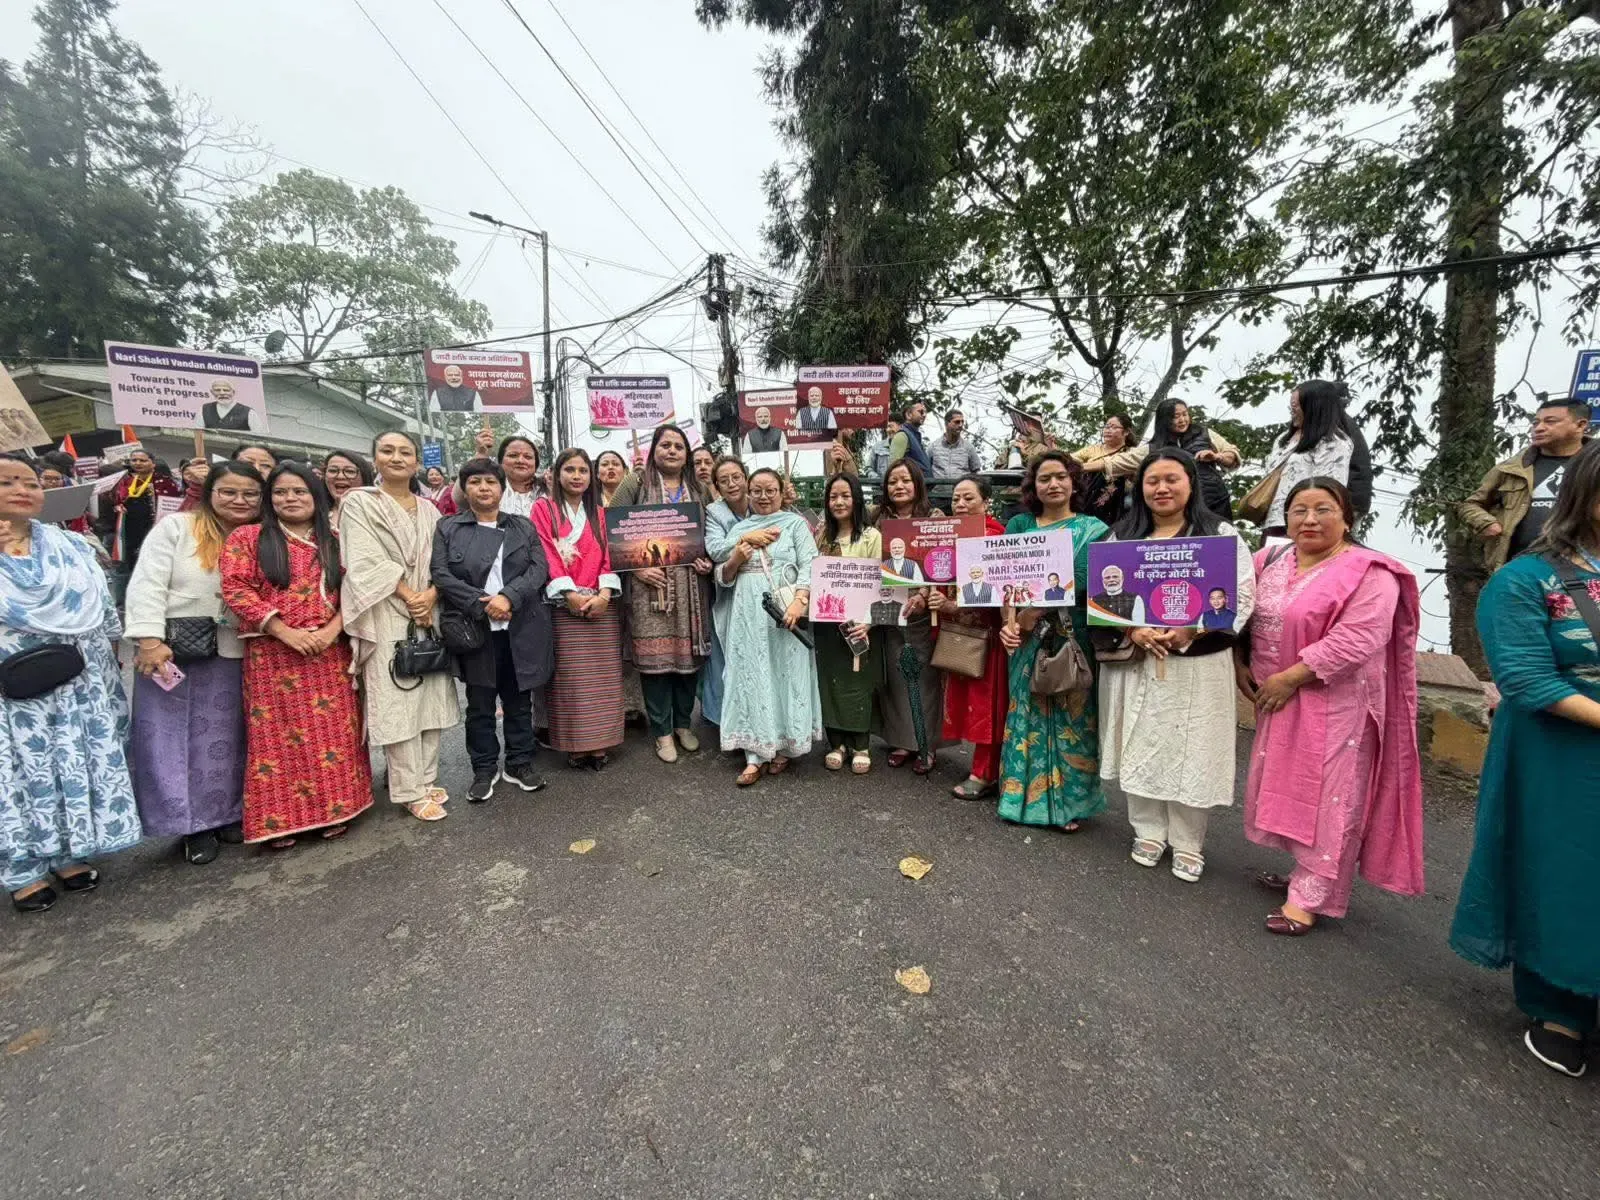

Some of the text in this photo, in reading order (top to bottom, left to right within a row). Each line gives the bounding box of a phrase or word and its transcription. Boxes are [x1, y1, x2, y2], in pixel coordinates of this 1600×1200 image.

[115, 352, 254, 375] Nari Shakti Vandan Adhiniyam
[804, 370, 817, 378] नारी
[818, 370, 834, 378] शक्ति
[851, 370, 884, 378] अधिनियम
[130, 373, 196, 387] Towards The
[490, 379, 521, 388] अधिकार
[118, 384, 210, 399] Nation's Progress
[862, 387, 880, 396] भारत
[1578, 382, 1599, 391] AND
[157, 398, 176, 406] and
[846, 395, 870, 404] के लिए
[142, 408, 196, 420] Prosperity
[868, 405, 884, 414] आगे
[920, 525, 954, 534] धन्यवाद
[984, 536, 1046, 548] THANK YOU
[981, 554, 996, 562] SHRI
[996, 552, 1028, 560] NARENDRA
[1029, 550, 1044, 558] MODI
[1144, 550, 1194, 562] धन्यवाद
[826, 562, 841, 570] नारी
[842, 563, 858, 571] शक्ति
[988, 564, 1045, 575] NARI SHAKTI
[820, 571, 862, 580] अधिनियमको
[1134, 570, 1144, 579] श्री
[1168, 568, 1190, 578] मोदी
[1192, 568, 1205, 578] जी
[830, 580, 874, 590] हार्दिक आभार
[1162, 582, 1188, 594] नारी
[1162, 595, 1188, 606] शक्ति
